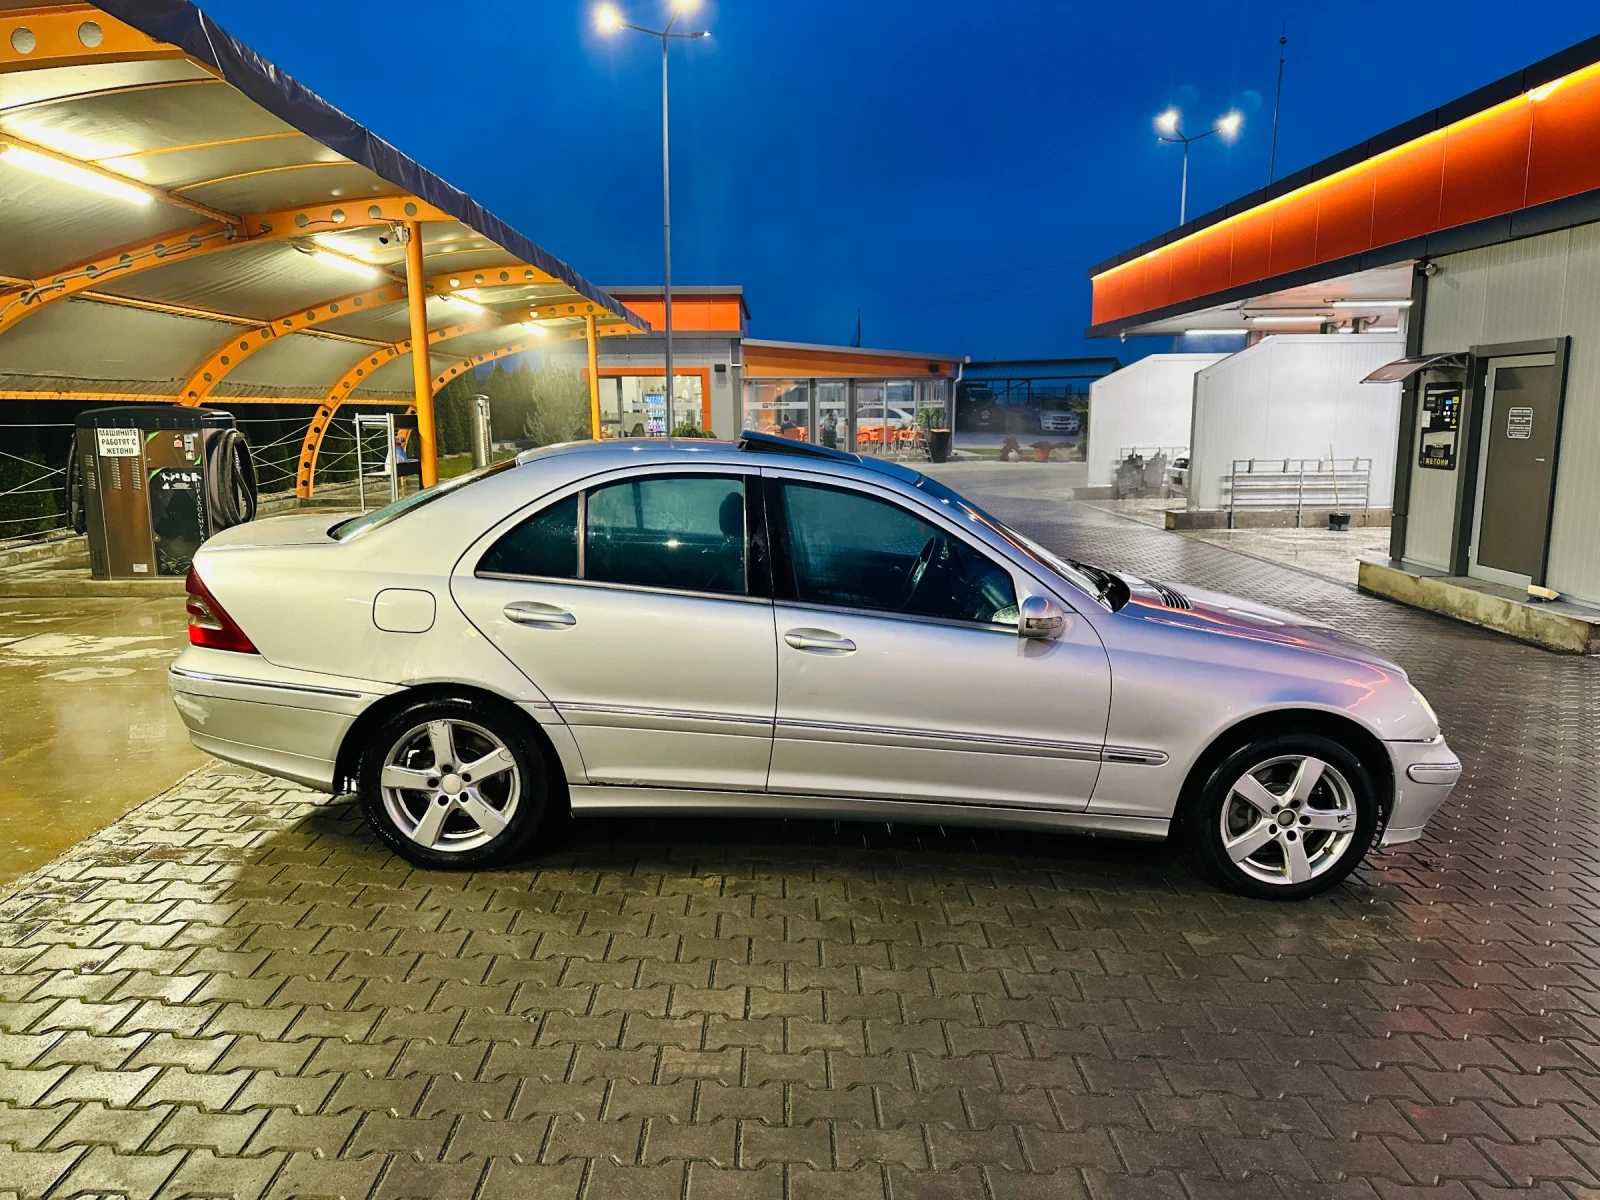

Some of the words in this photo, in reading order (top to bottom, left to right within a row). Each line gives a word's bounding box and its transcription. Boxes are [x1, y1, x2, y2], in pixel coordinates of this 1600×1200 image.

[99, 429, 137, 437] МАШИНИТЕ
[101, 438, 130, 446] РАБОТЯТ
[131, 438, 137, 446] С
[106, 447, 134, 455] ЖЕТОНИ
[1425, 457, 1449, 466] ЖЕТОНИ
[194, 482, 206, 546] ПРАХОСМУКА
